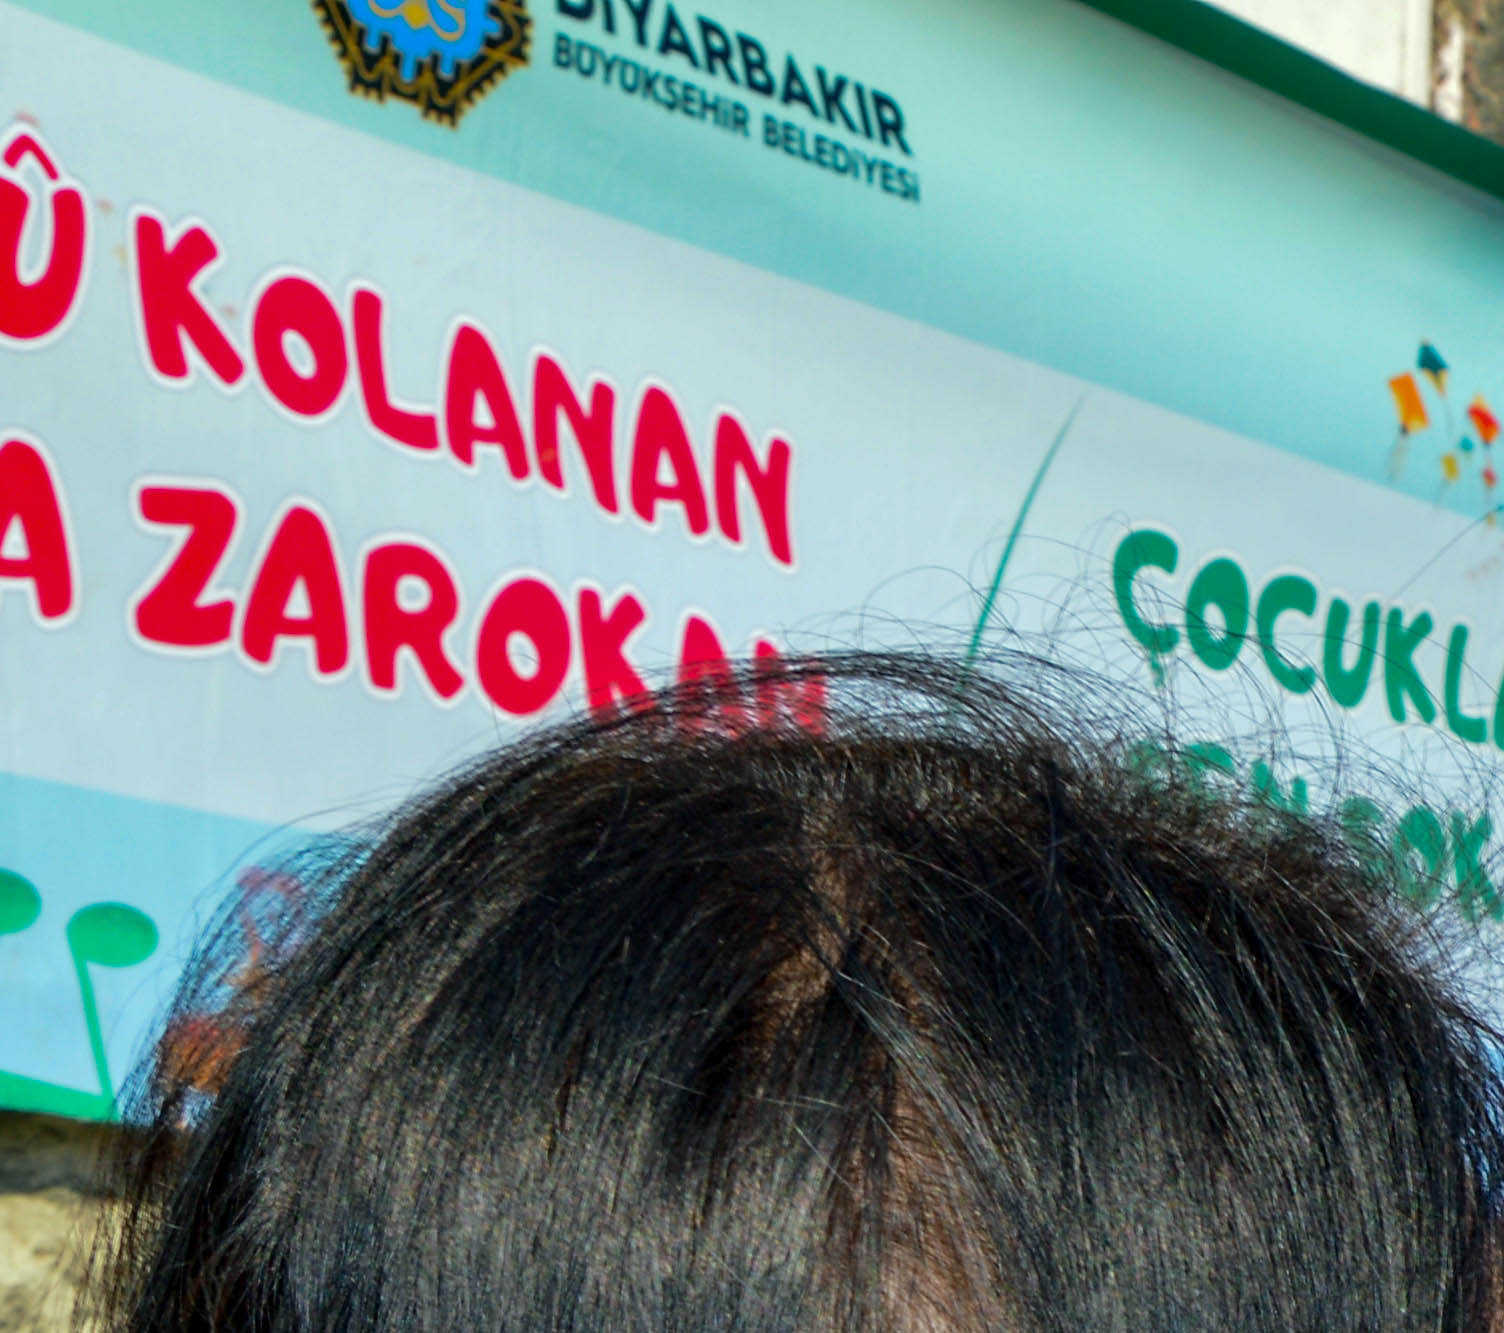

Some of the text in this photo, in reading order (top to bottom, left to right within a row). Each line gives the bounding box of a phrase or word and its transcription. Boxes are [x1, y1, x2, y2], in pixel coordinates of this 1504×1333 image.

[762, 113, 920, 202] BELEDİYESİ
[134, 214, 793, 565] KOLANAN
[134, 485, 828, 740] ZAROKAN
